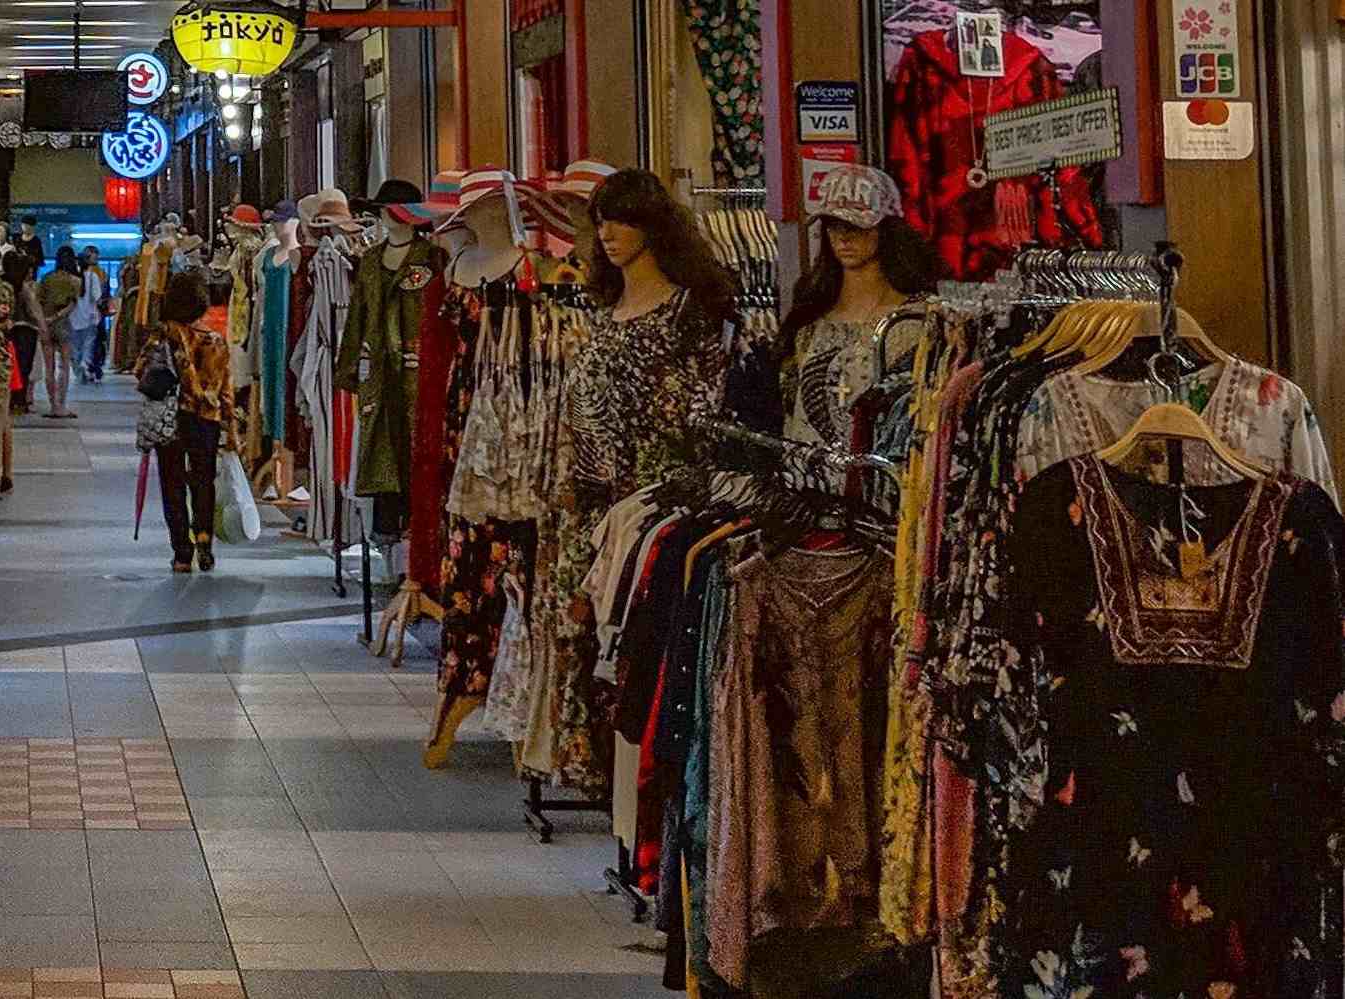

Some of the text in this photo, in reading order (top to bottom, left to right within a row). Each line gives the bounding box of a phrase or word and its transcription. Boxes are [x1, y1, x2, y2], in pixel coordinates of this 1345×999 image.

[800, 85, 855, 98] Welcome
[809, 115, 849, 130] VISA
[1052, 114, 1074, 139] BEST
[1075, 107, 1109, 134] OFFER
